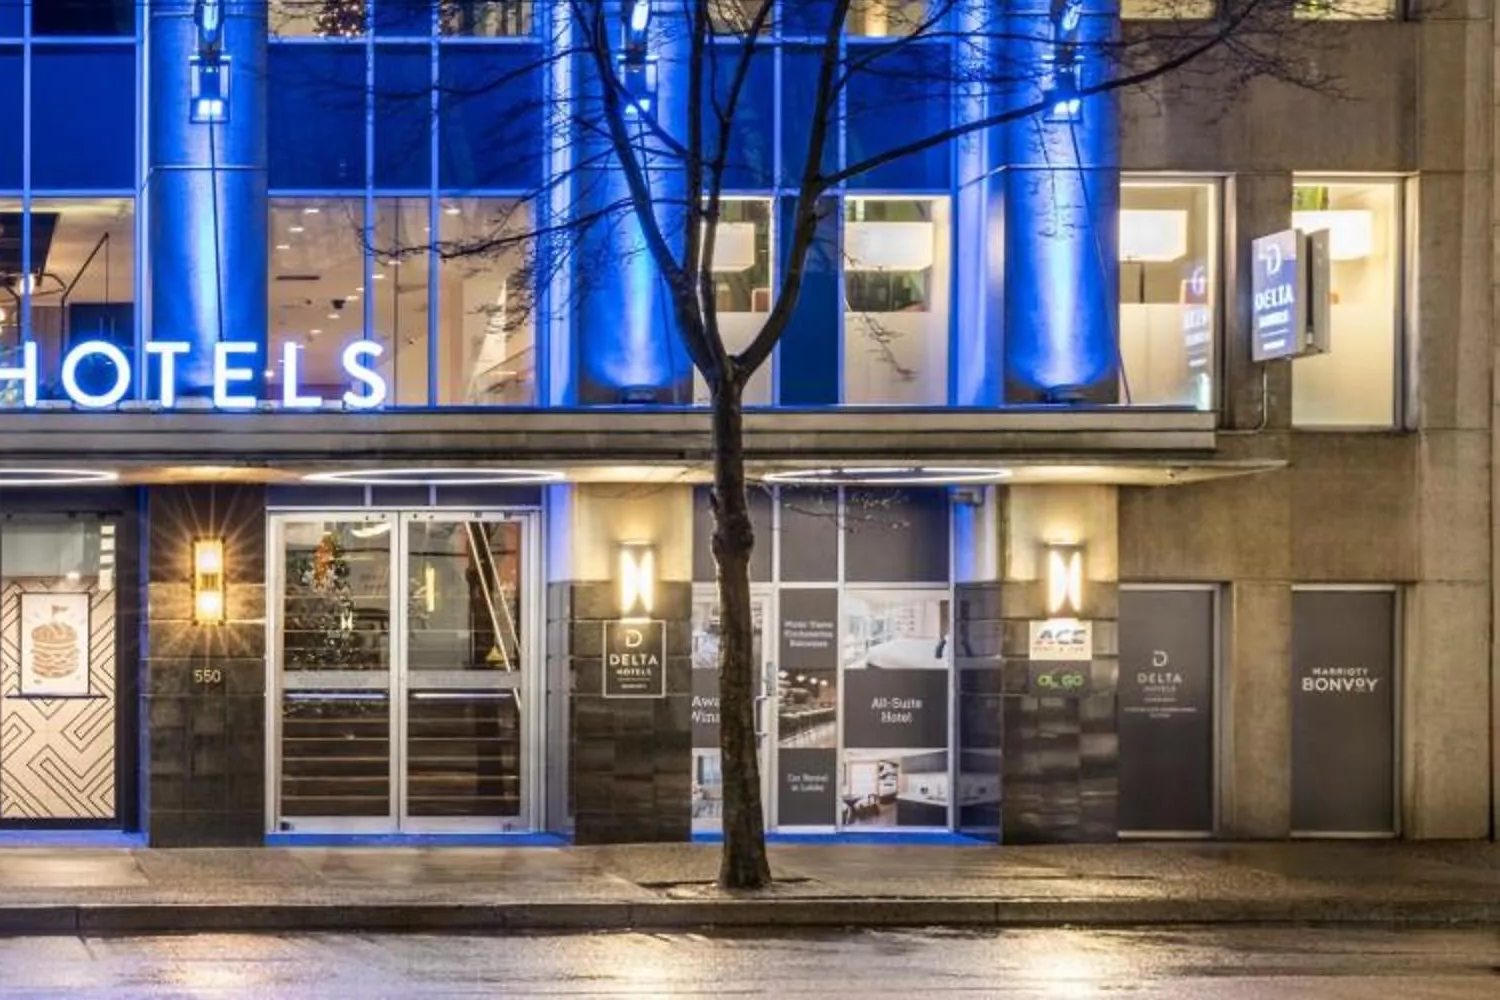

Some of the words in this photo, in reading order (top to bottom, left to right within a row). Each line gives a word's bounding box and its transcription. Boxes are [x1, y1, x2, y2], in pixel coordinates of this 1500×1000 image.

[1255, 284, 1295, 311] DELTA
[1035, 628, 1087, 646] ACE
[609, 653, 659, 667] DELTA
[194, 669, 221, 683] 550
[1137, 672, 1182, 684] DELTA
[1312, 667, 1368, 676] MARRIOTT
[1302, 677, 1378, 692] BONVOY
[871, 697, 923, 709] All-Suite
[881, 711, 913, 723] Hotel
